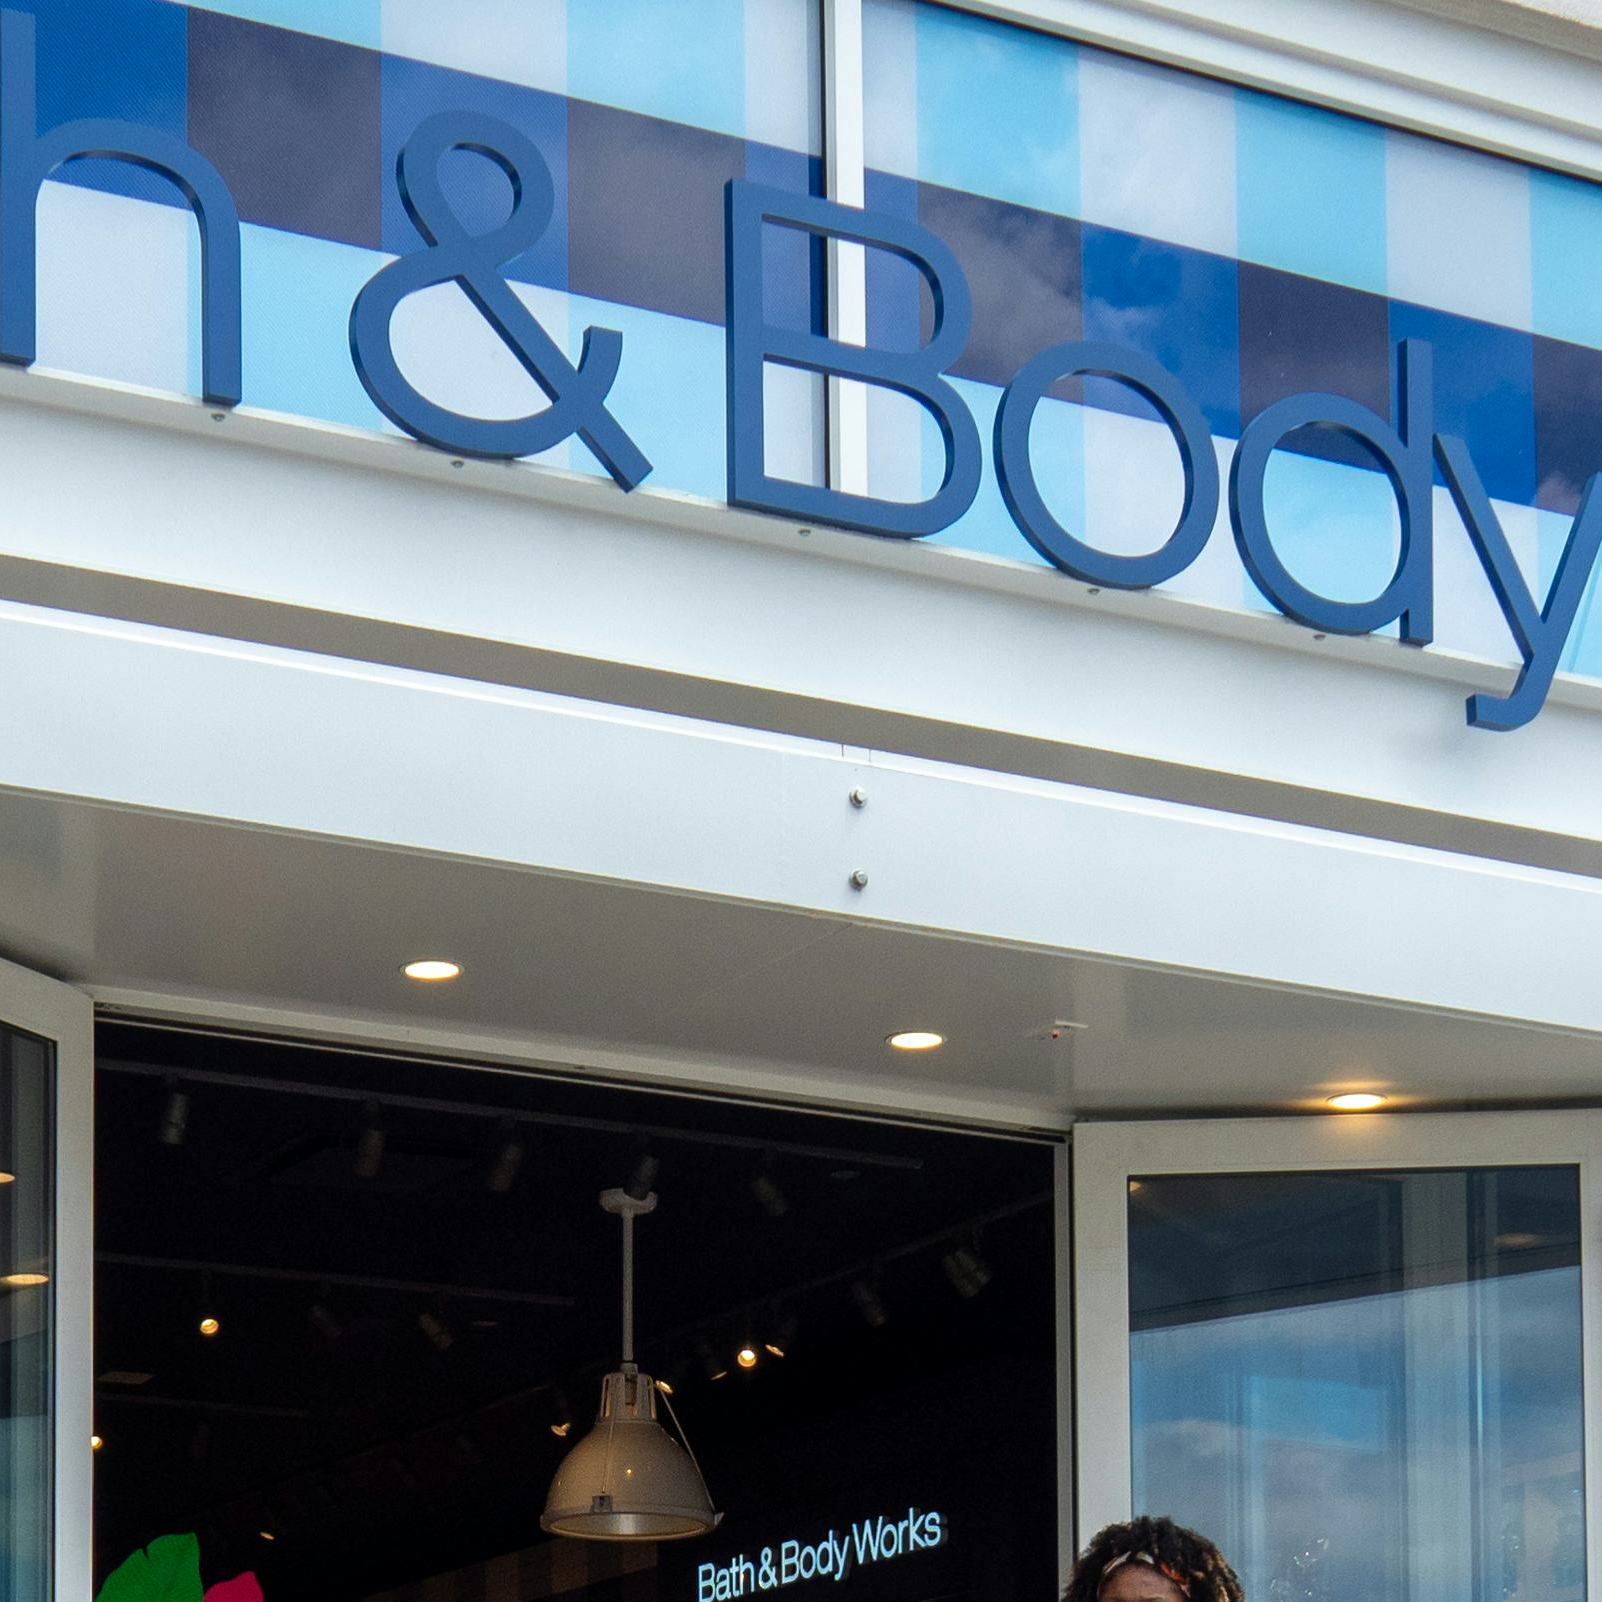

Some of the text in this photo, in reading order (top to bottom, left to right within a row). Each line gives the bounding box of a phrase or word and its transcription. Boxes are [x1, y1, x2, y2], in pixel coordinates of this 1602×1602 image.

[351, 112, 654, 492] &
[759, 1547, 777, 1589] &
[782, 1530, 849, 1584] Body
[853, 1508, 941, 1564] Works
